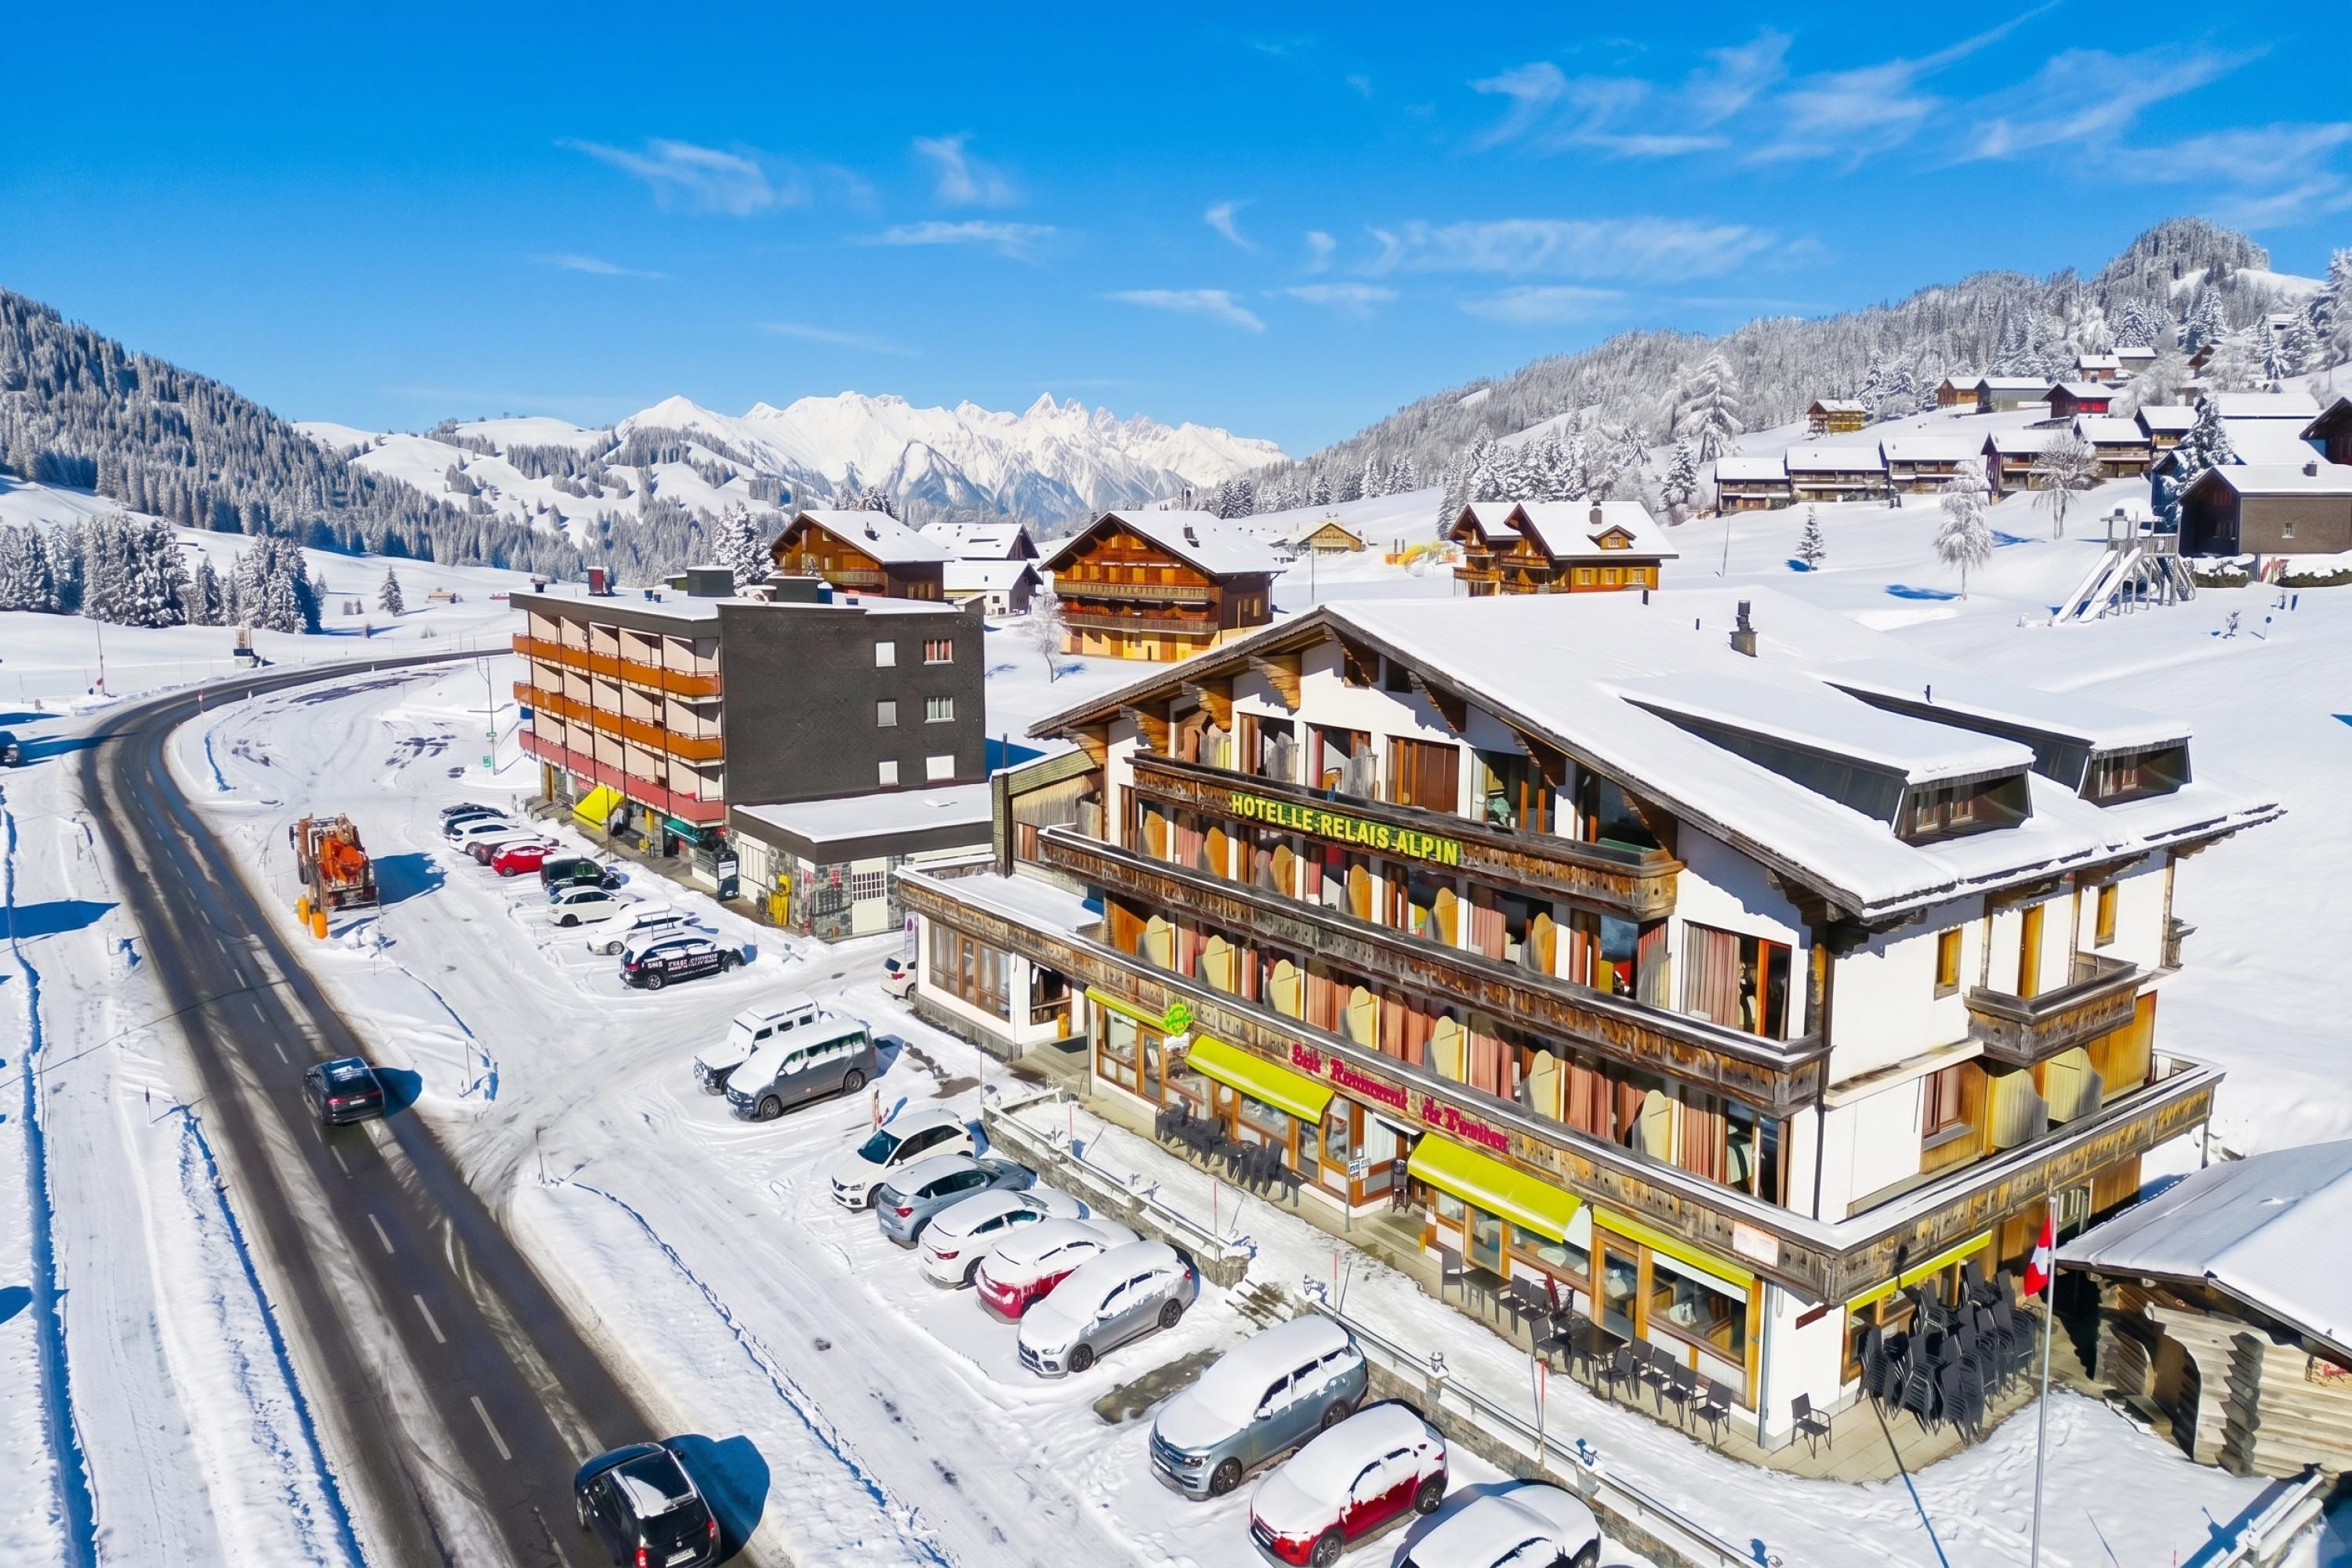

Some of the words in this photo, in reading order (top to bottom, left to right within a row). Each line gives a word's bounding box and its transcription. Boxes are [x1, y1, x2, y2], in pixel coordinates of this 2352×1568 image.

[1232, 794, 1287, 826] HOTEL
[1291, 807, 1314, 832] LE
[1320, 815, 1391, 850] RELAIS
[1396, 831, 1458, 866] ALPIN
